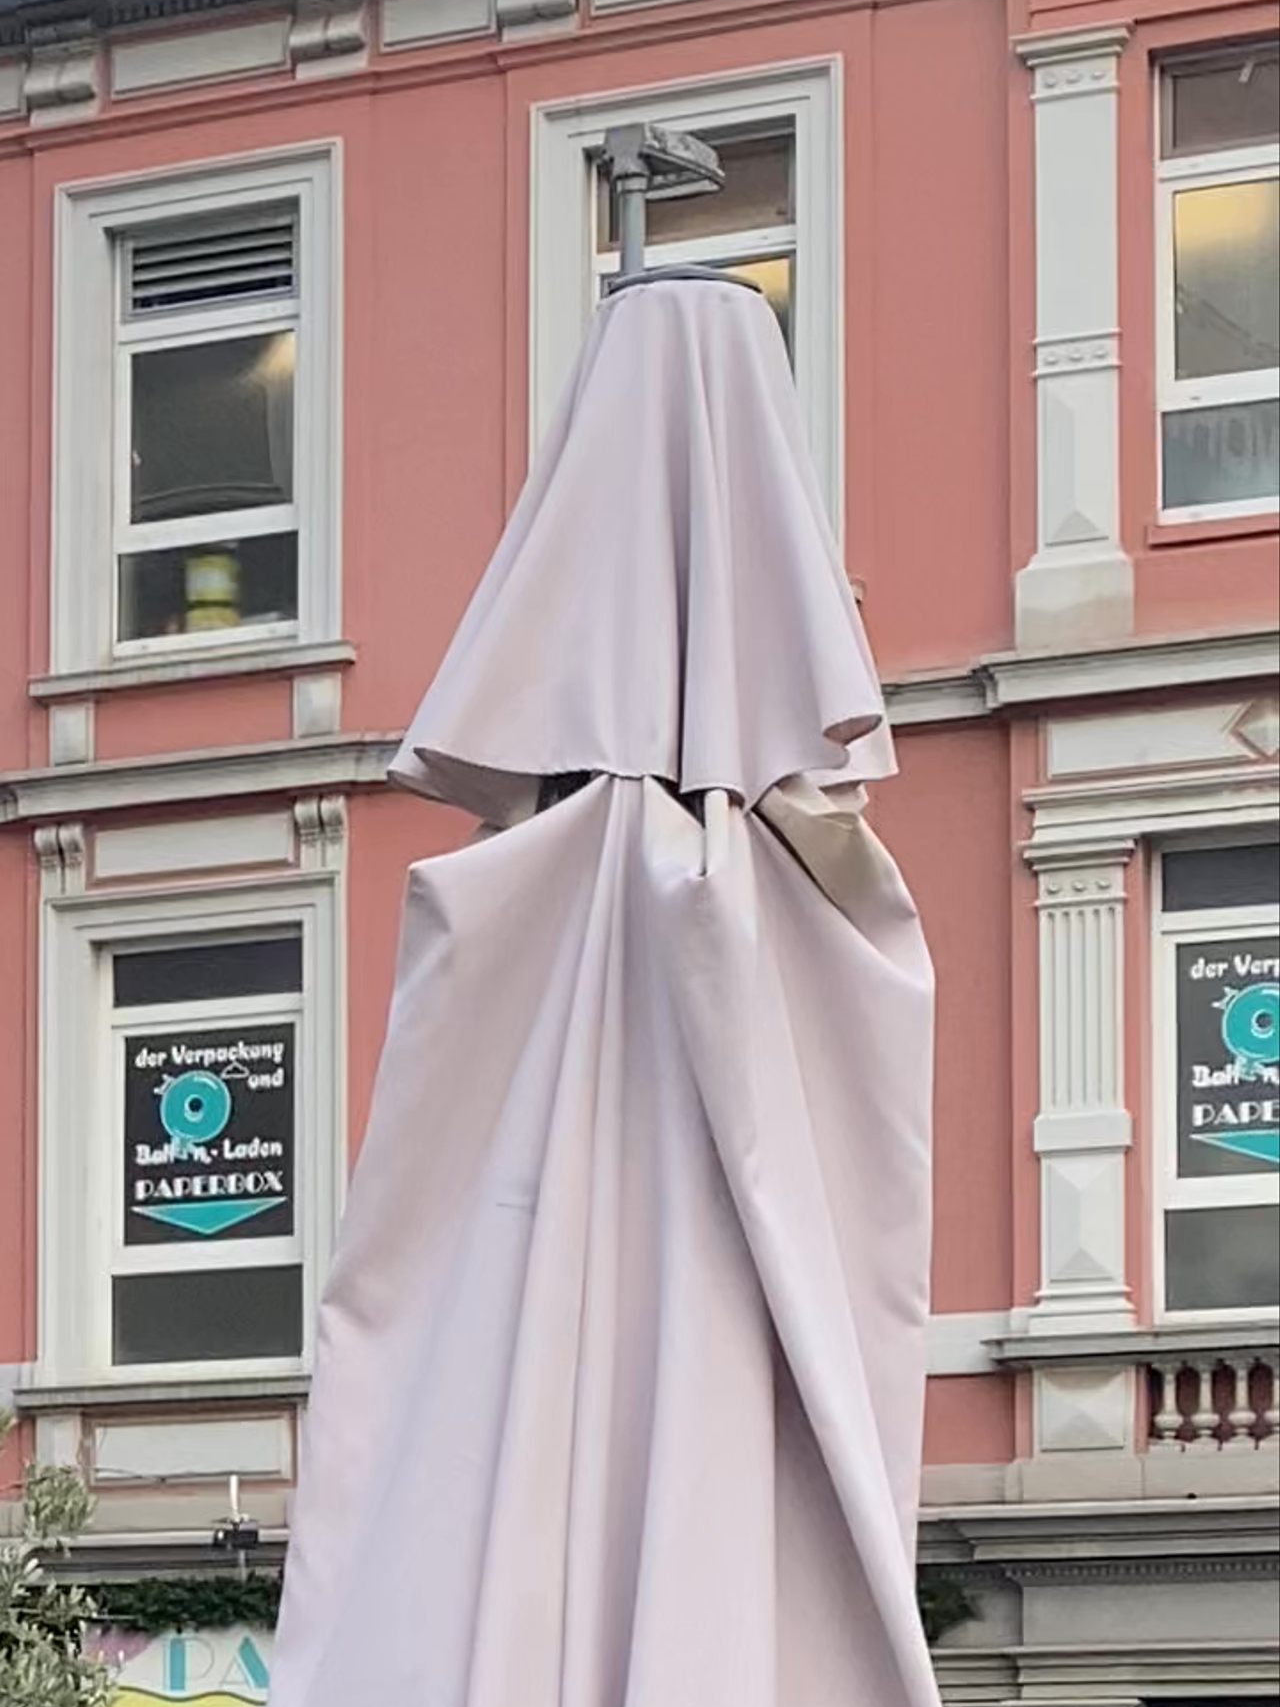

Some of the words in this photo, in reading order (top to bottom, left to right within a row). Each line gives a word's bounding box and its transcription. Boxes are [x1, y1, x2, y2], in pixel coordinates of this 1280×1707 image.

[1190, 956, 1228, 980] der
[135, 1048, 168, 1069] der
[171, 1041, 285, 1068] Verpackung
[135, 1170, 284, 1201] PAPERBOX
